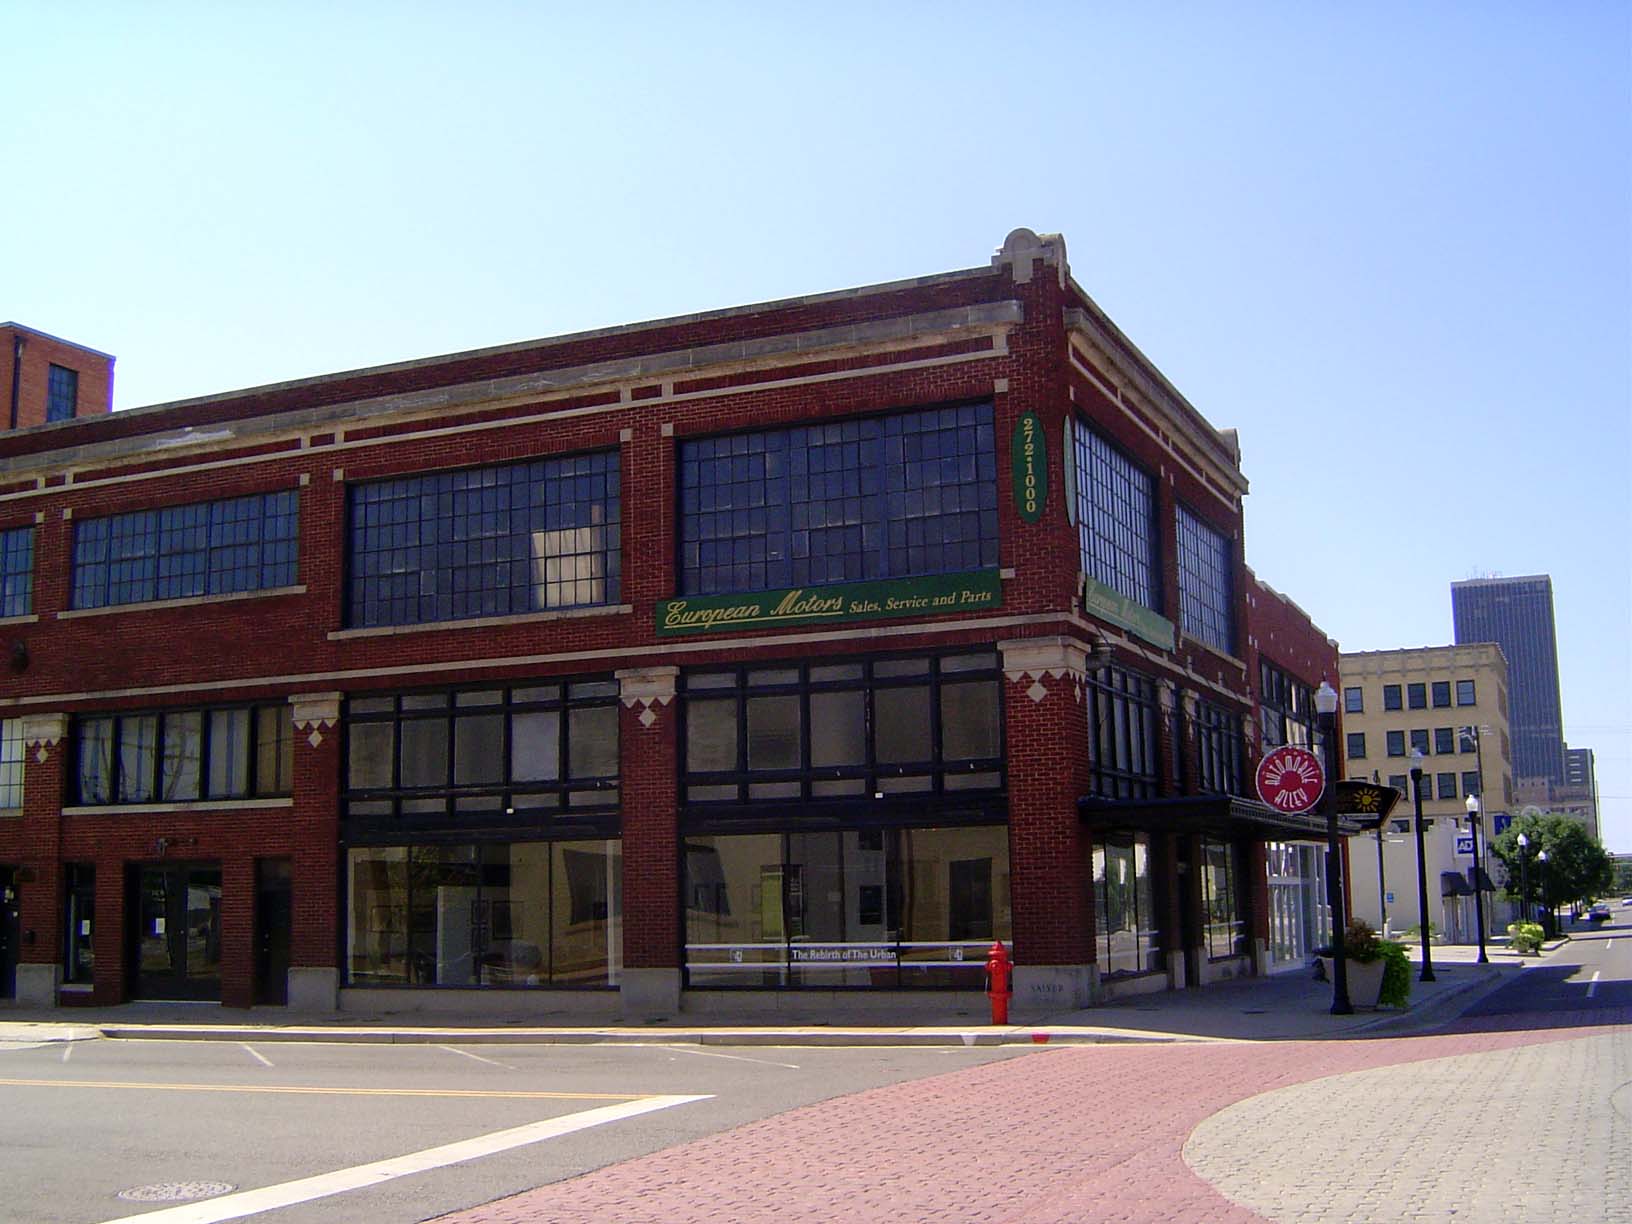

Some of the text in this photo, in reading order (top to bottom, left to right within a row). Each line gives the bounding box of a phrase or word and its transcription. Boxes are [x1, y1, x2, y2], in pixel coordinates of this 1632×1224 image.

[665, 601, 760, 628] European
[770, 590, 843, 615] Motors
[886, 595, 928, 610] Service
[932, 592, 956, 606] and
[960, 590, 992, 603] Parts
[1264, 755, 1318, 785] AUTOMOBILE
[1274, 788, 1308, 808] ALLEY
[792, 948, 897, 960] The Rebirth of The Urban
